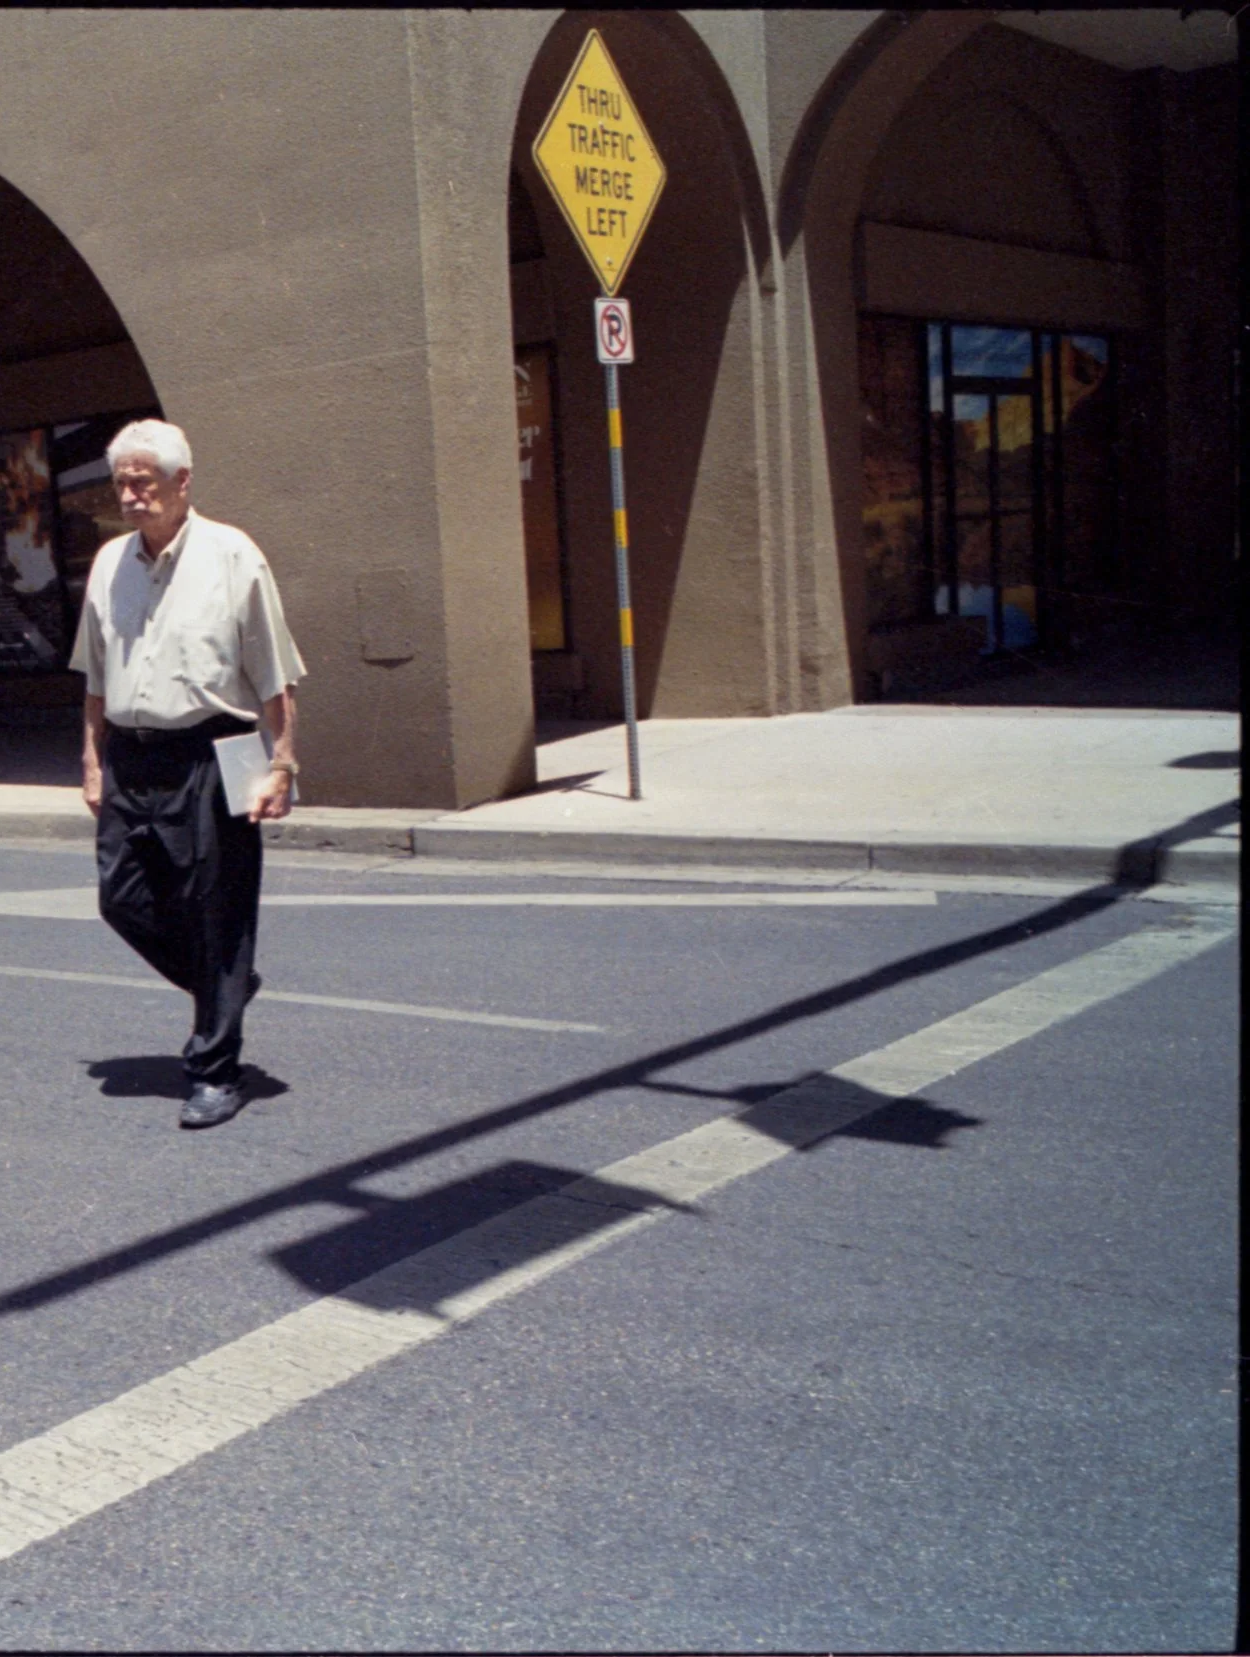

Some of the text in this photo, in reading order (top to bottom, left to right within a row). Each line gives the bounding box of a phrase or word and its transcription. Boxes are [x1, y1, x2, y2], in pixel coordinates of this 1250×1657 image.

[577, 84, 621, 120] THRU
[567, 123, 635, 162] TRAFFIC
[575, 165, 634, 201] MERGE
[586, 207, 627, 238] LEFT
